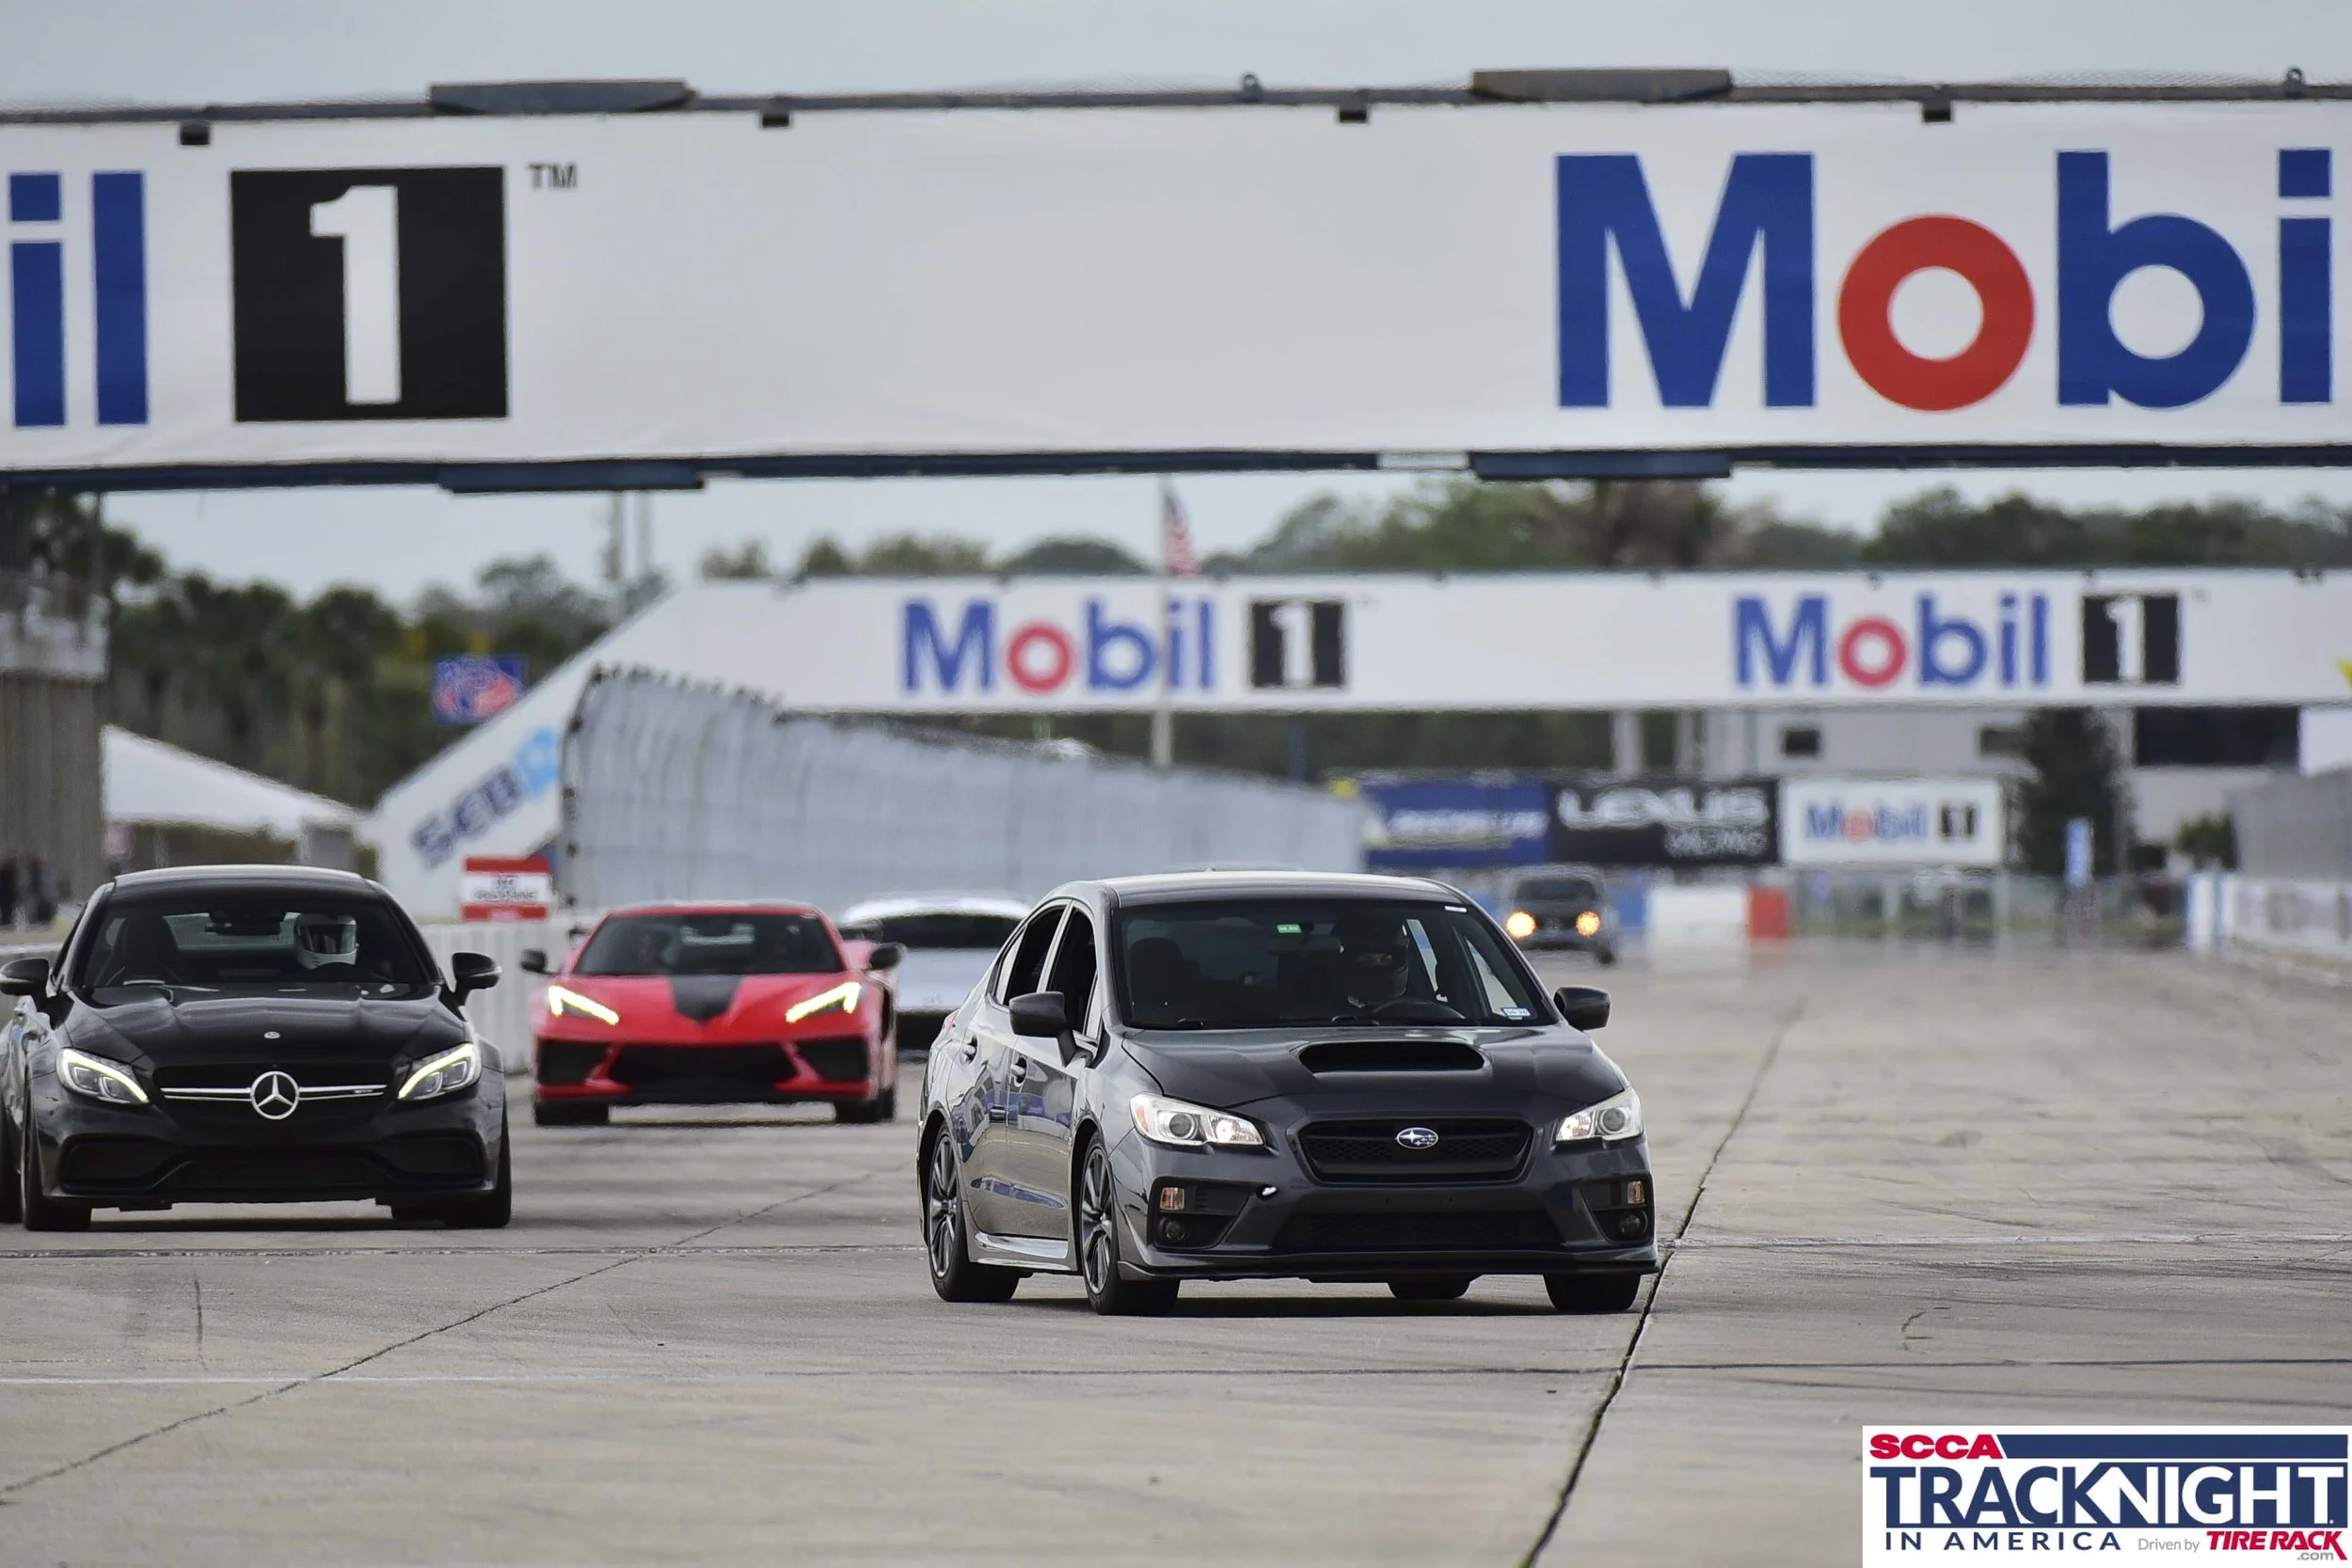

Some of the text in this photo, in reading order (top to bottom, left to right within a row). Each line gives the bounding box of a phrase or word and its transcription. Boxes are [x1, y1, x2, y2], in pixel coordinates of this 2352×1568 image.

[529, 163, 578, 190] TM
[901, 597, 1216, 694] Mobil
[1733, 593, 2051, 689] Mobil
[1805, 800, 1928, 840] Mobil
